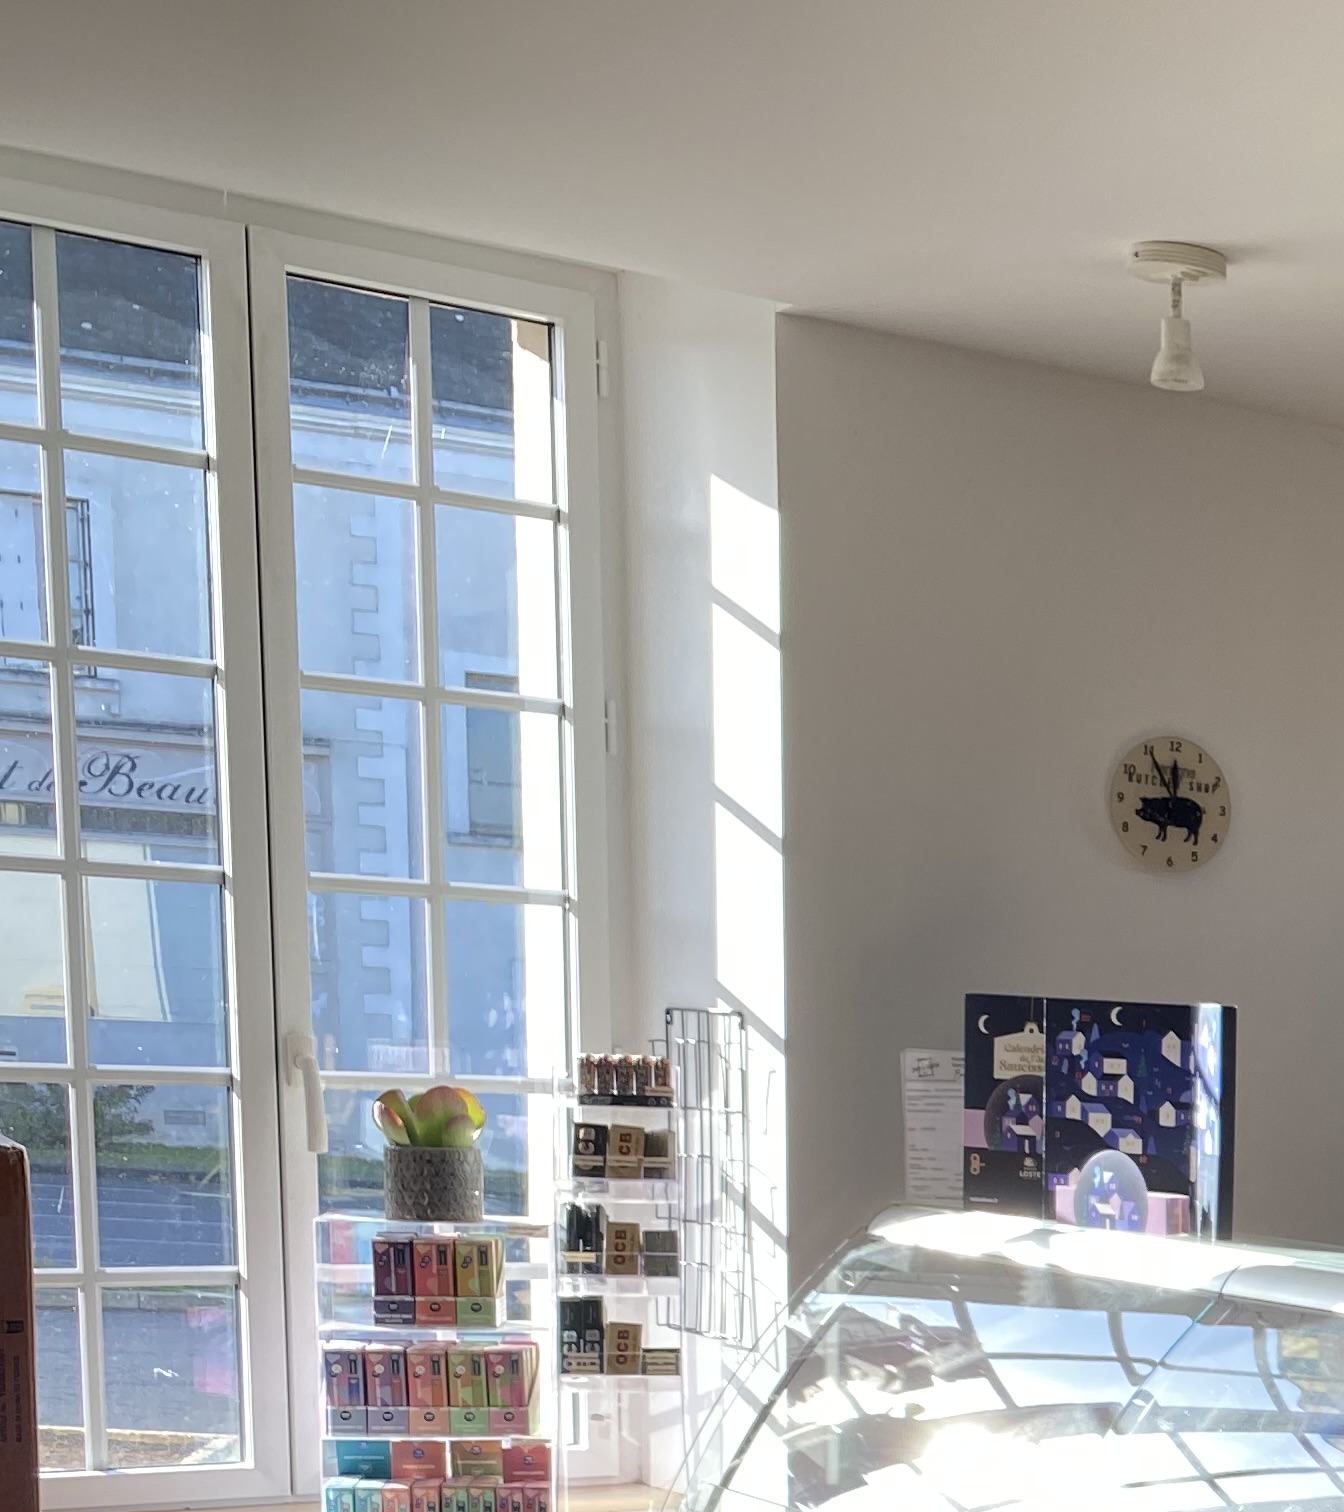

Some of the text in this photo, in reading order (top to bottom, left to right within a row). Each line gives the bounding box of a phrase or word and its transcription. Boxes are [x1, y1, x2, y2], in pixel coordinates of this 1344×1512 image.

[1170, 741, 1182, 753] 12
[1117, 792, 1125, 802] 9
[1219, 806, 1226, 817] 3
[1122, 821, 1129, 832] 8
[1211, 833, 1219, 843] 4
[1140, 845, 1148, 856] 7
[1166, 856, 1174, 867] 6
[1191, 852, 1198, 862] 5
[614, 1229, 628, 1267] OCB
[616, 1329, 630, 1366] OCB
